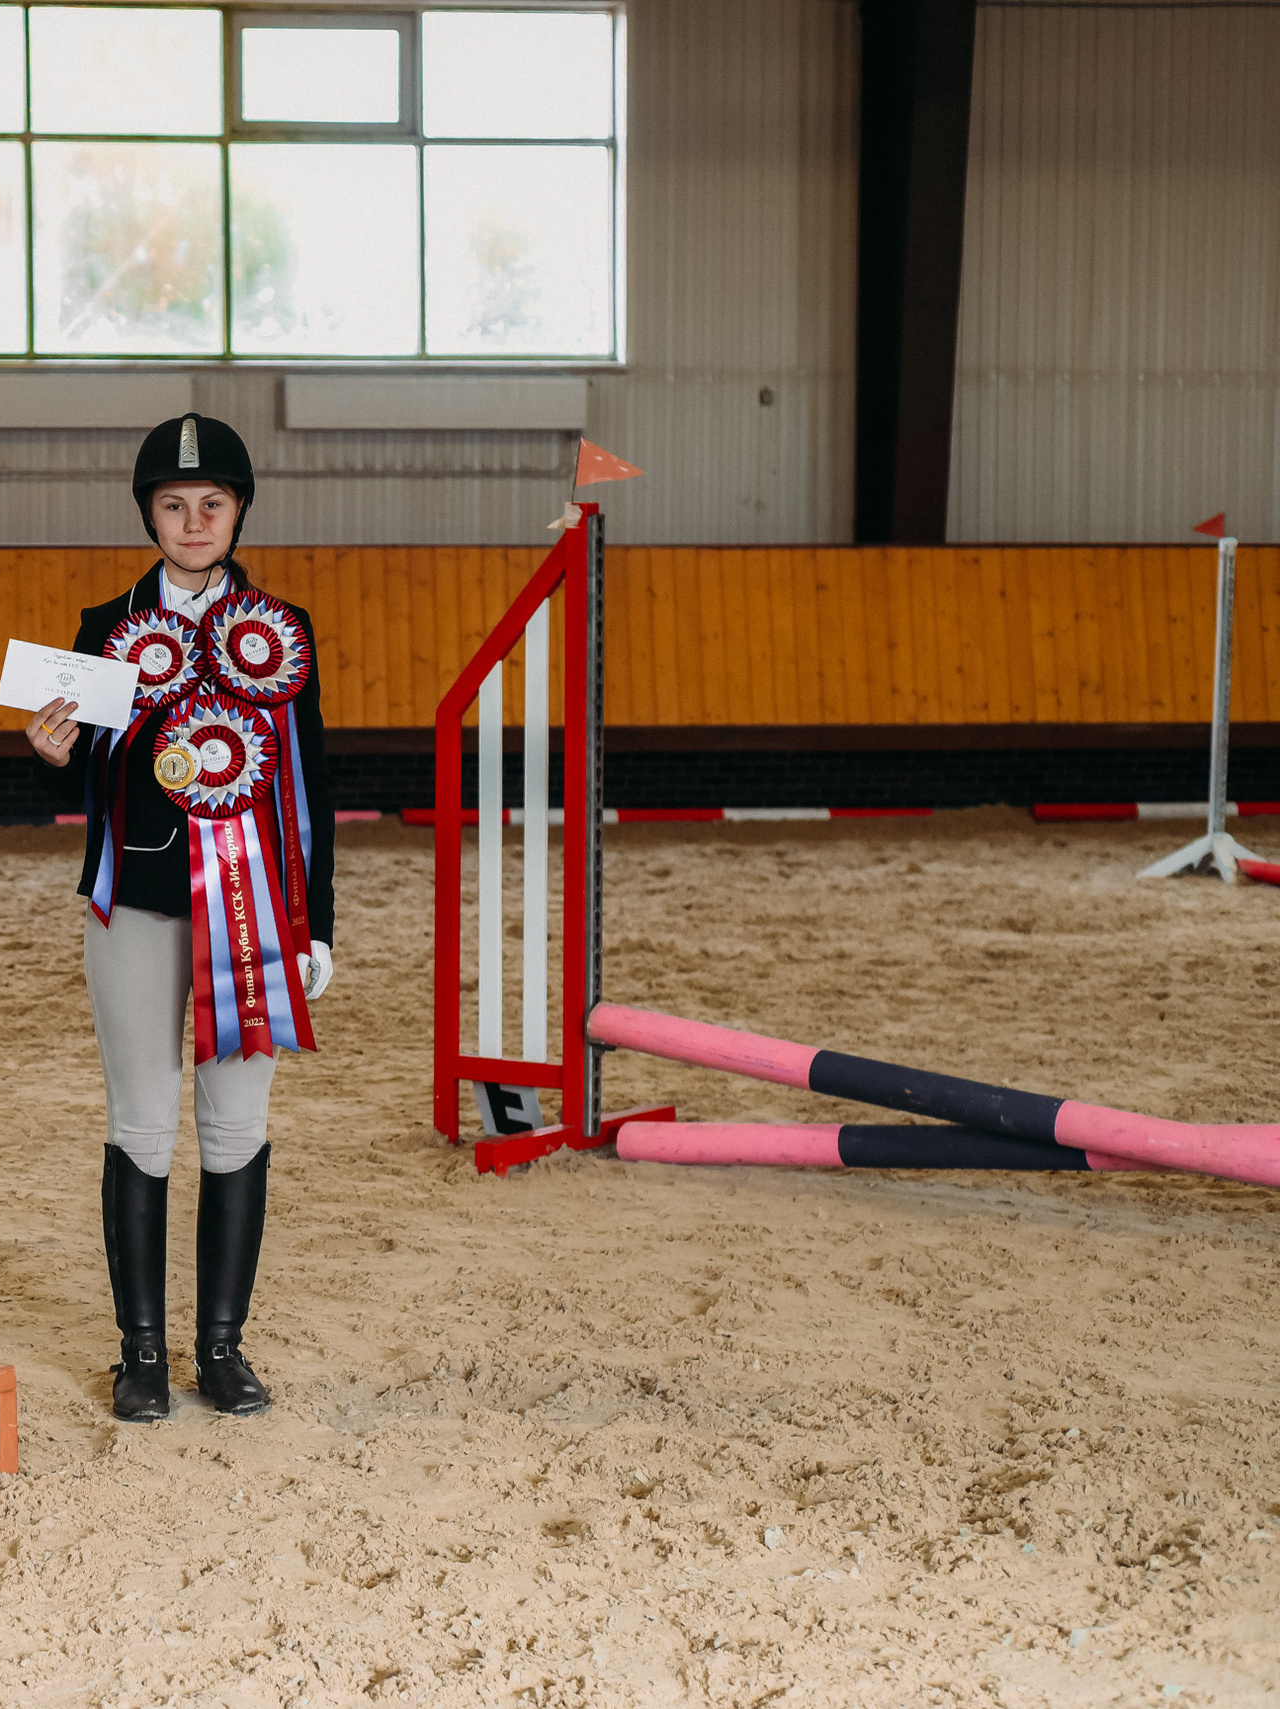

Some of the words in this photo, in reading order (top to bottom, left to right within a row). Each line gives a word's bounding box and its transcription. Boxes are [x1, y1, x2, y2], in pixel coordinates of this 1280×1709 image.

[224, 820, 241, 888] «История»
[231, 890, 246, 922] КСК
[238, 922, 254, 963] Кубка
[244, 965, 257, 1008] Финал
[243, 1017, 265, 1028] 2022
